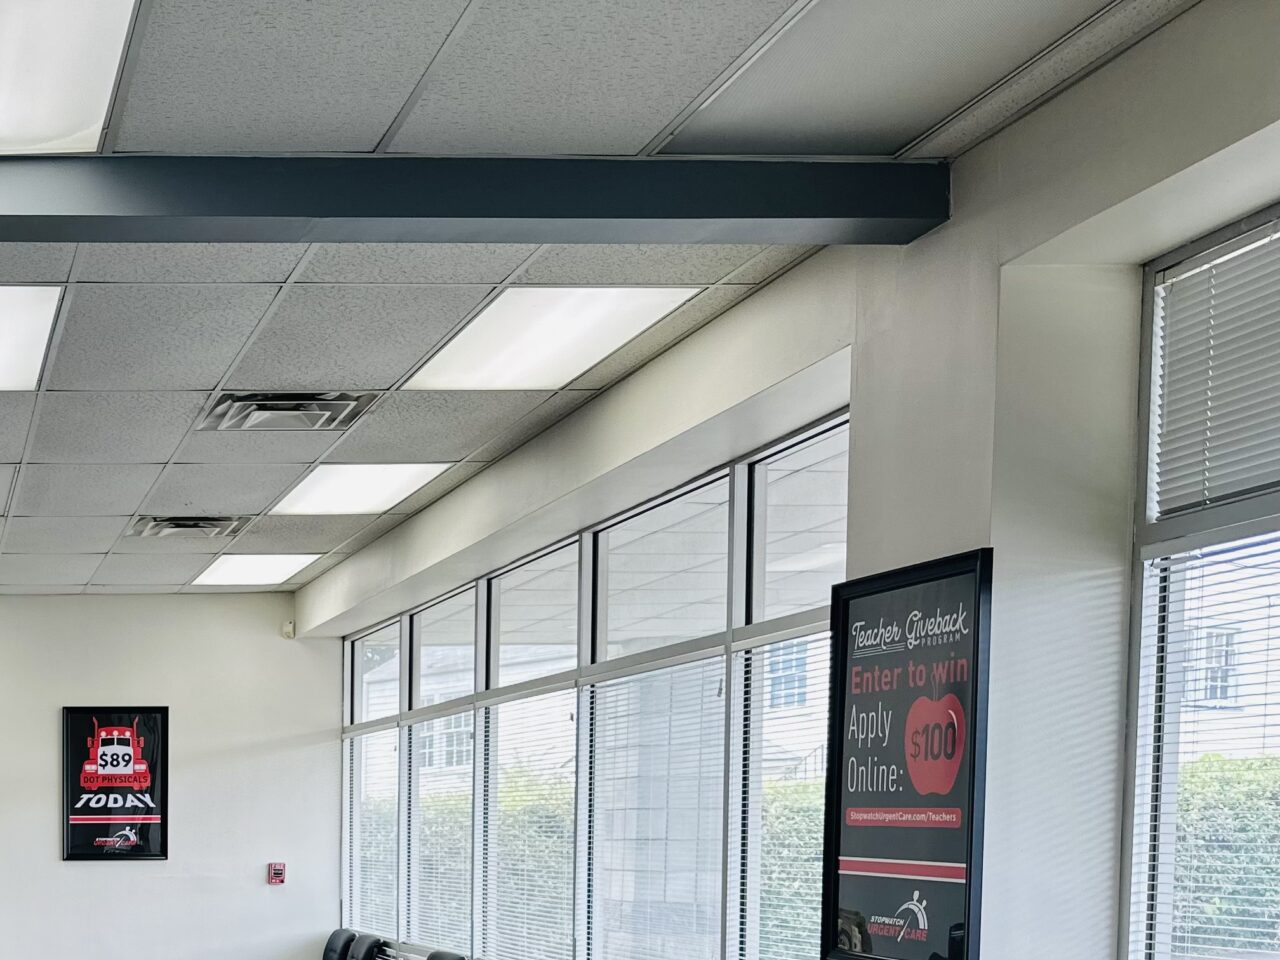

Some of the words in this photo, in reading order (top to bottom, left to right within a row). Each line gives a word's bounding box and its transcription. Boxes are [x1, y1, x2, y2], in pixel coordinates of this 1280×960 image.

[852, 617, 902, 650] Teacher
[905, 602, 969, 650] Giveback
[921, 632, 961, 647] PROGRAM
[851, 664, 902, 694] Enter
[908, 660, 927, 688] to
[932, 652, 968, 684] win
[848, 701, 893, 748] Apply
[910, 720, 958, 762] $100
[98, 750, 132, 770] $89
[83, 775, 99, 784] DOT
[102, 775, 149, 784] PHYSICALS
[847, 755, 904, 793] Online:
[74, 793, 156, 808] TODAY
[850, 810, 956, 823] StopwatchUrgentCare.com/Teachers
[869, 915, 905, 926] STOPWATCH
[867, 923, 902, 938] URGENT
[904, 928, 928, 941] CARE
